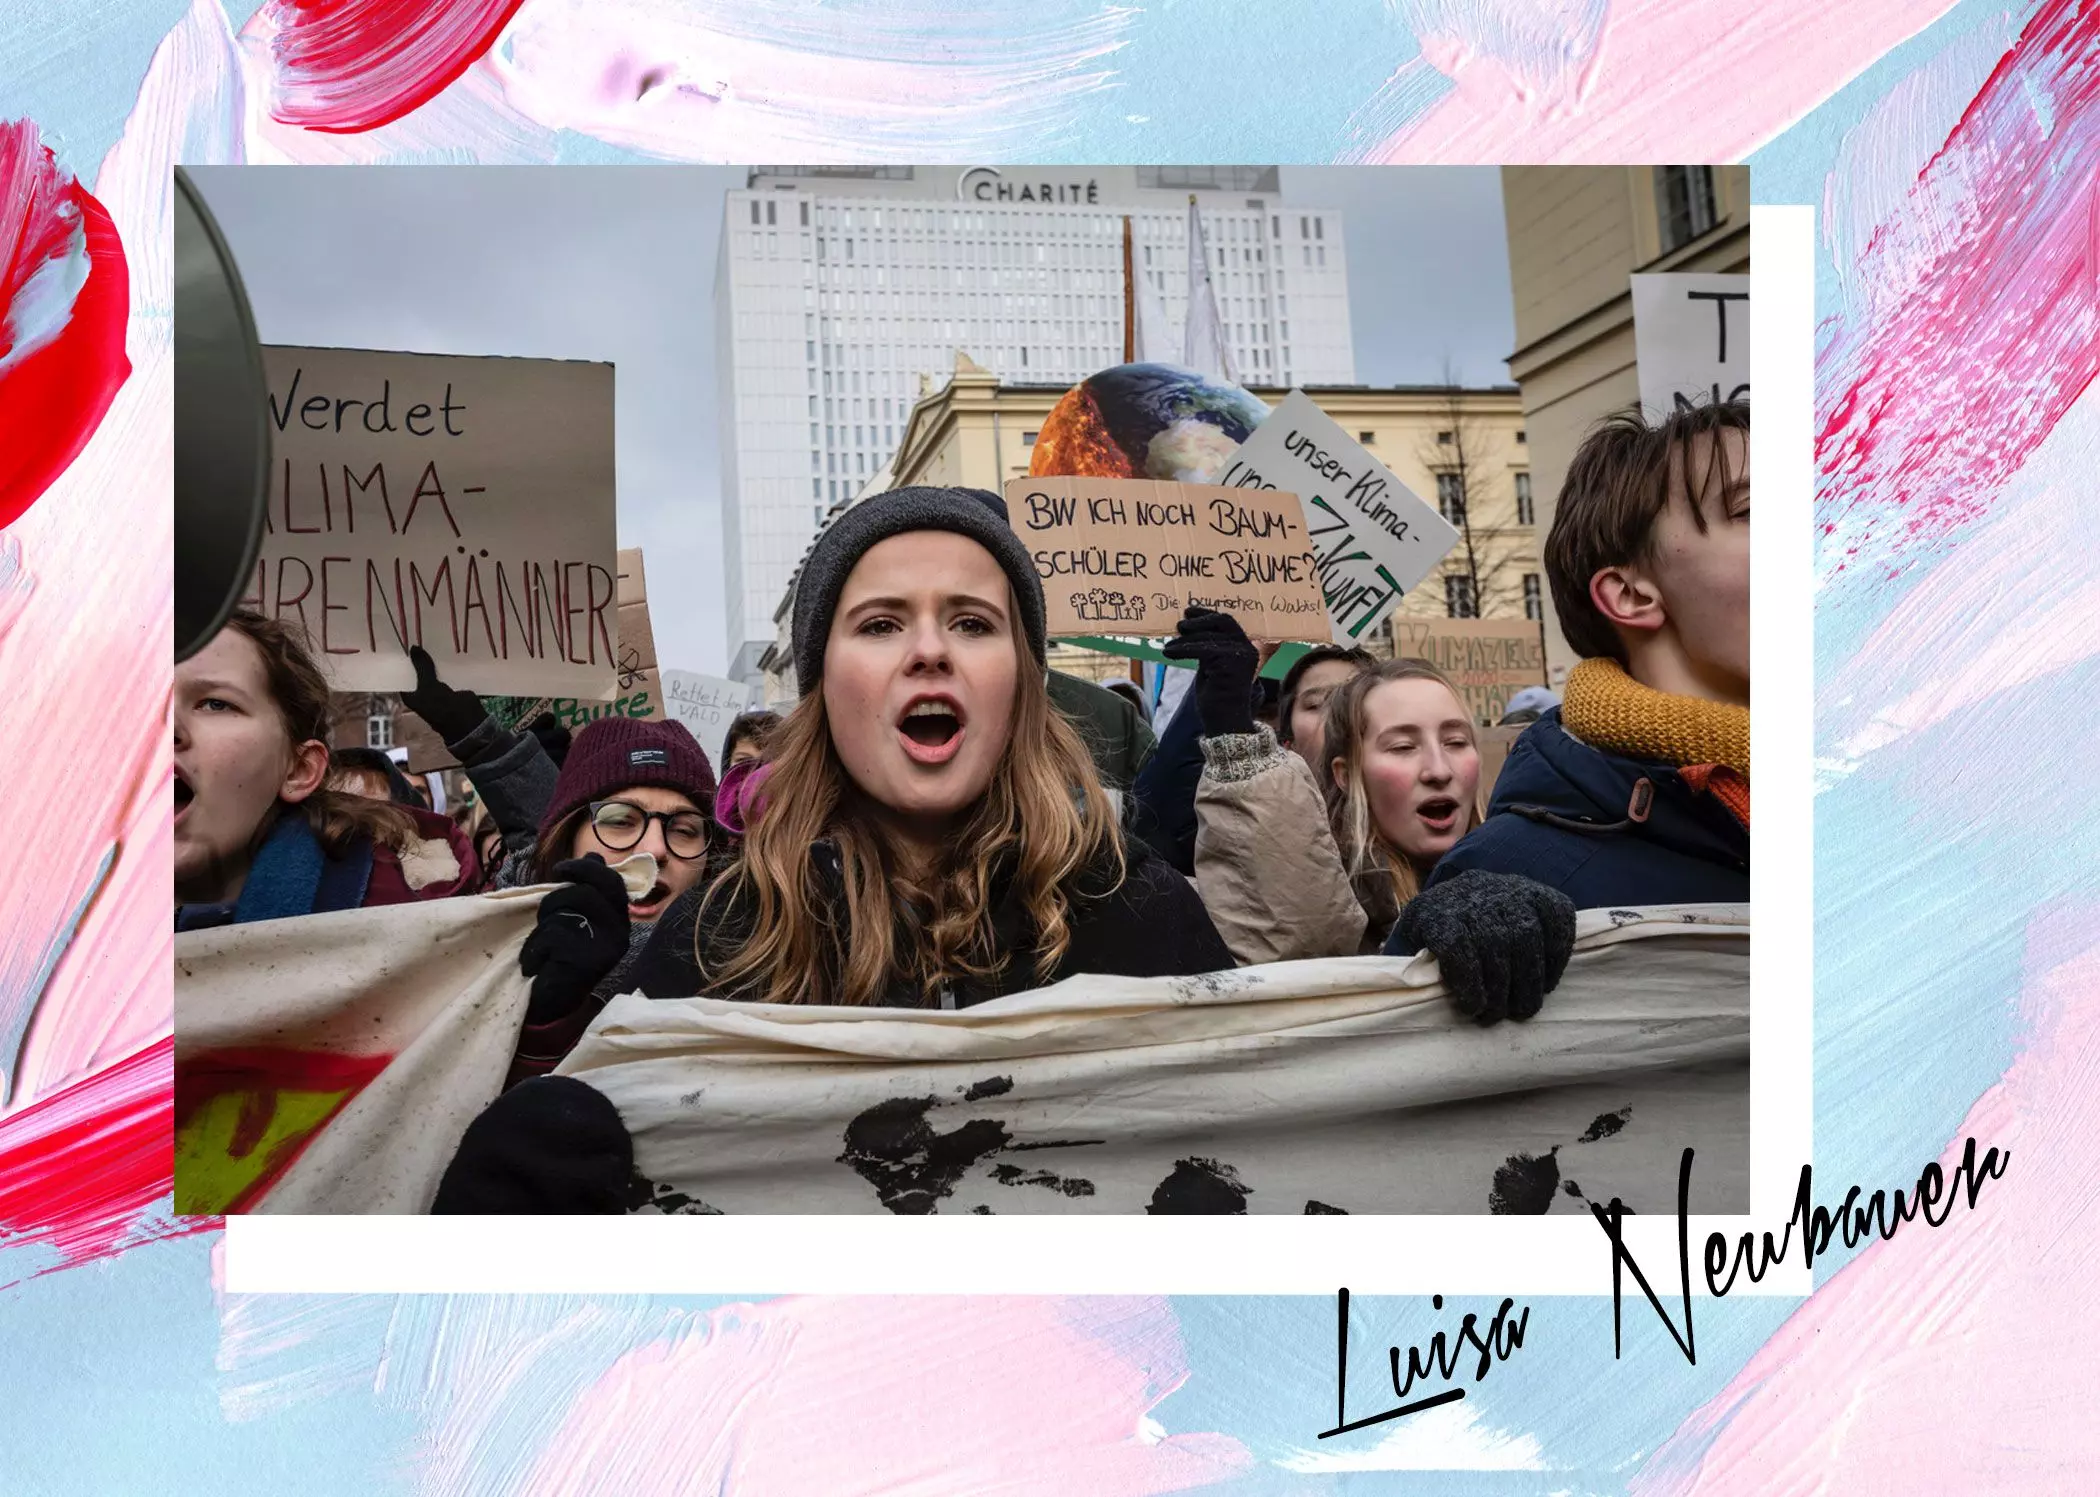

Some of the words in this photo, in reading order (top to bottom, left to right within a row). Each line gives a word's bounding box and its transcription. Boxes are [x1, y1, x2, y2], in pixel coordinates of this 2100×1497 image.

[974, 179, 1099, 204] CHARITÉ
[1285, 430, 1352, 483] unser
[266, 458, 486, 538] LIMA-
[1025, 492, 1077, 530] BW
[1087, 497, 1127, 526] ICH
[1136, 500, 1196, 527] NOCH
[1209, 499, 1298, 539] BAUM-
[1034, 546, 1148, 579] SCHÜLER
[1159, 553, 1215, 578] OHNE
[1219, 549, 1319, 590] BÄUME?
[1151, 592, 1180, 611] Die
